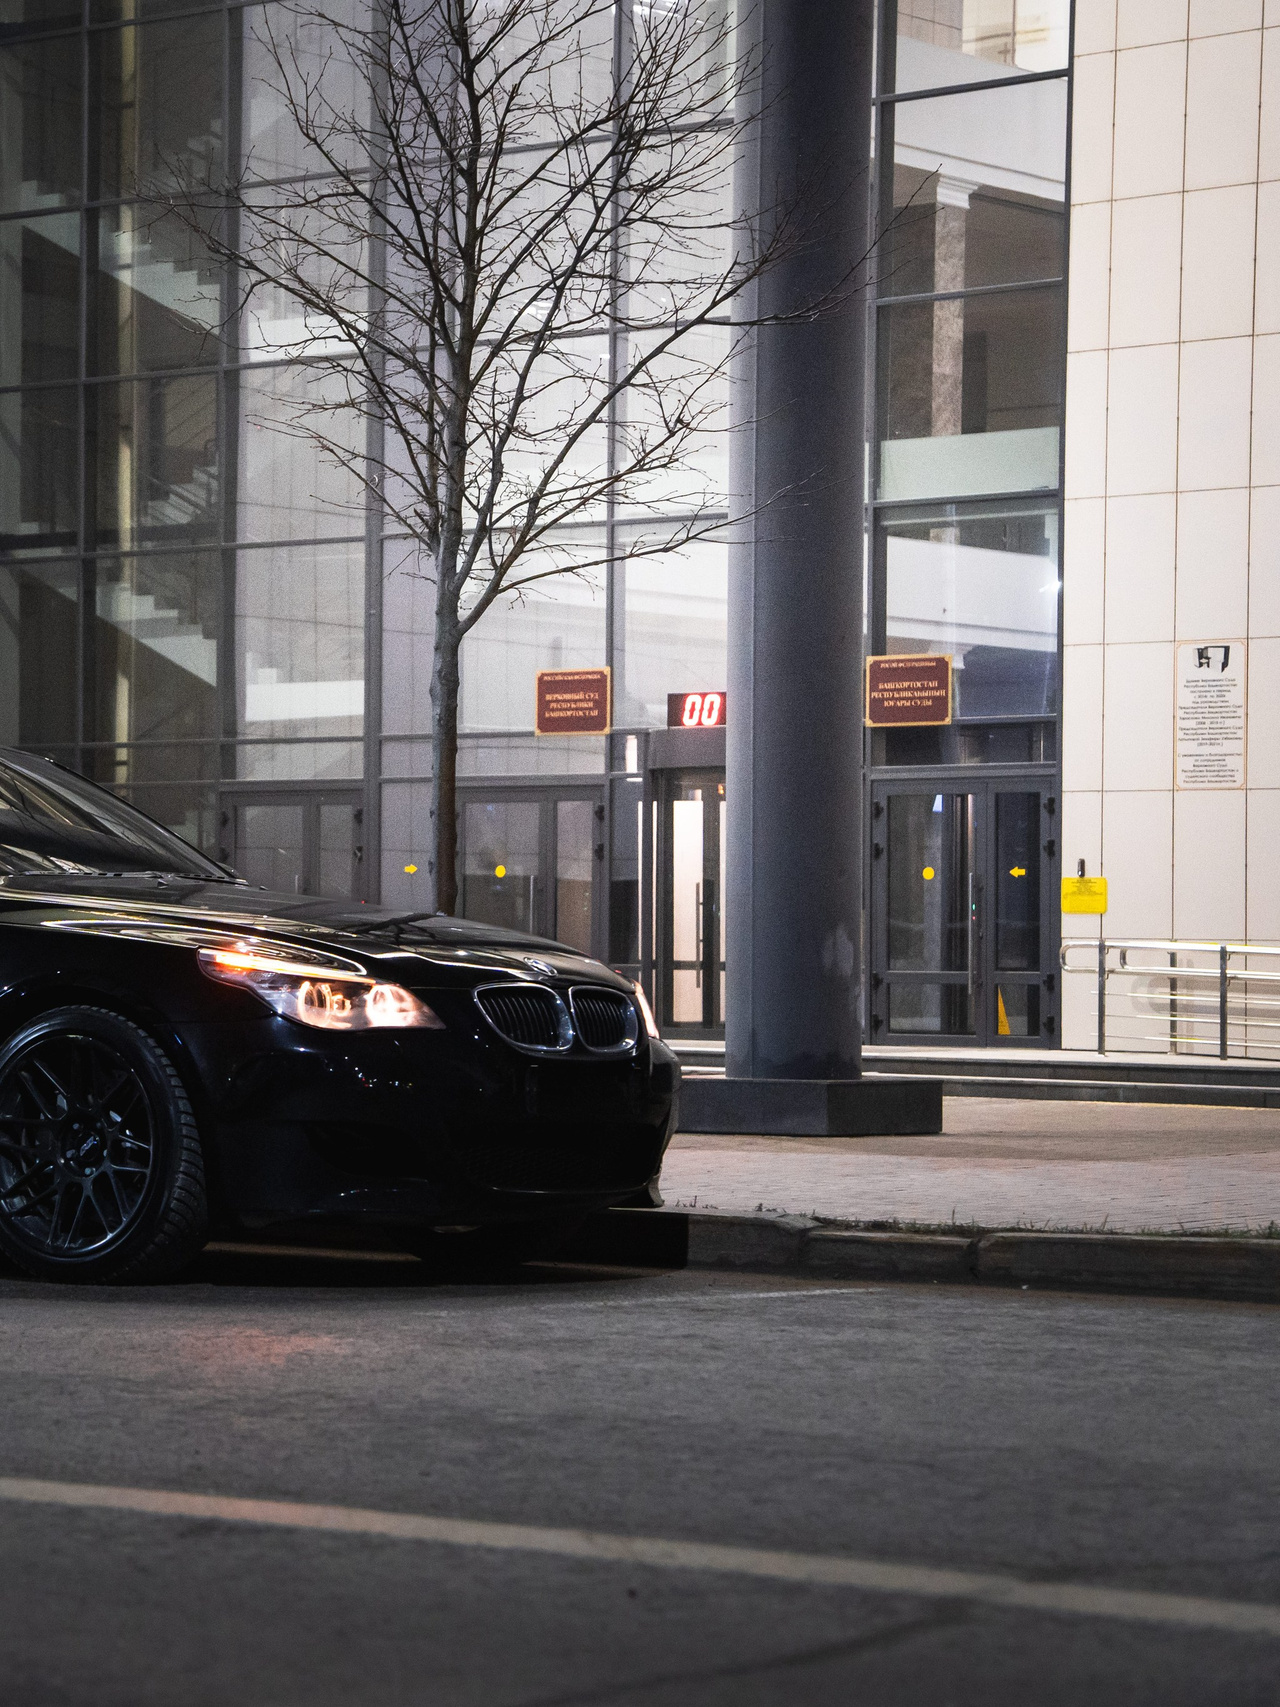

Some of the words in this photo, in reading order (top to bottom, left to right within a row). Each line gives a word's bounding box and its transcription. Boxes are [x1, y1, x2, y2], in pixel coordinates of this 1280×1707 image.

[545, 691, 585, 701] ВЕРХОВНЫЙ
[585, 692, 599, 700] СУД
[549, 701, 594, 709] РЕСПУБЛИКИ
[683, 693, 721, 726] 00
[545, 709, 599, 718] БАШКОРТОСТАН
